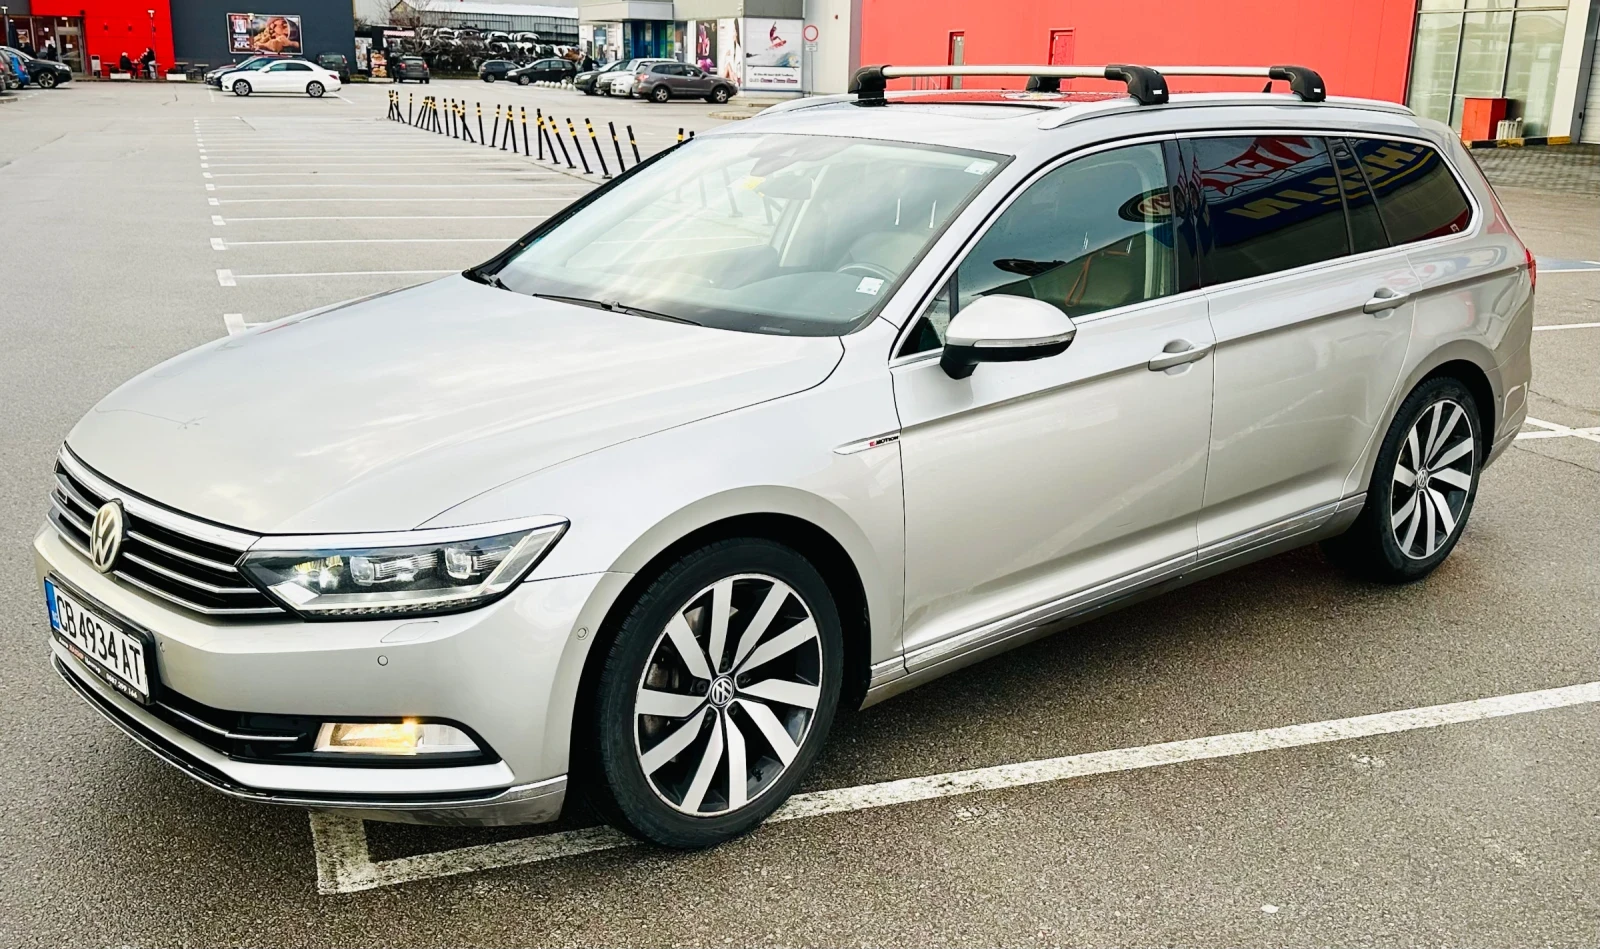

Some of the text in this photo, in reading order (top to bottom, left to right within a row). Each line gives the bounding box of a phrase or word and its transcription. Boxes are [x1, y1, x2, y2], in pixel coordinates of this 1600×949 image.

[57, 595, 77, 639] CB
[79, 612, 119, 669] 4934
[122, 639, 141, 685] AT
